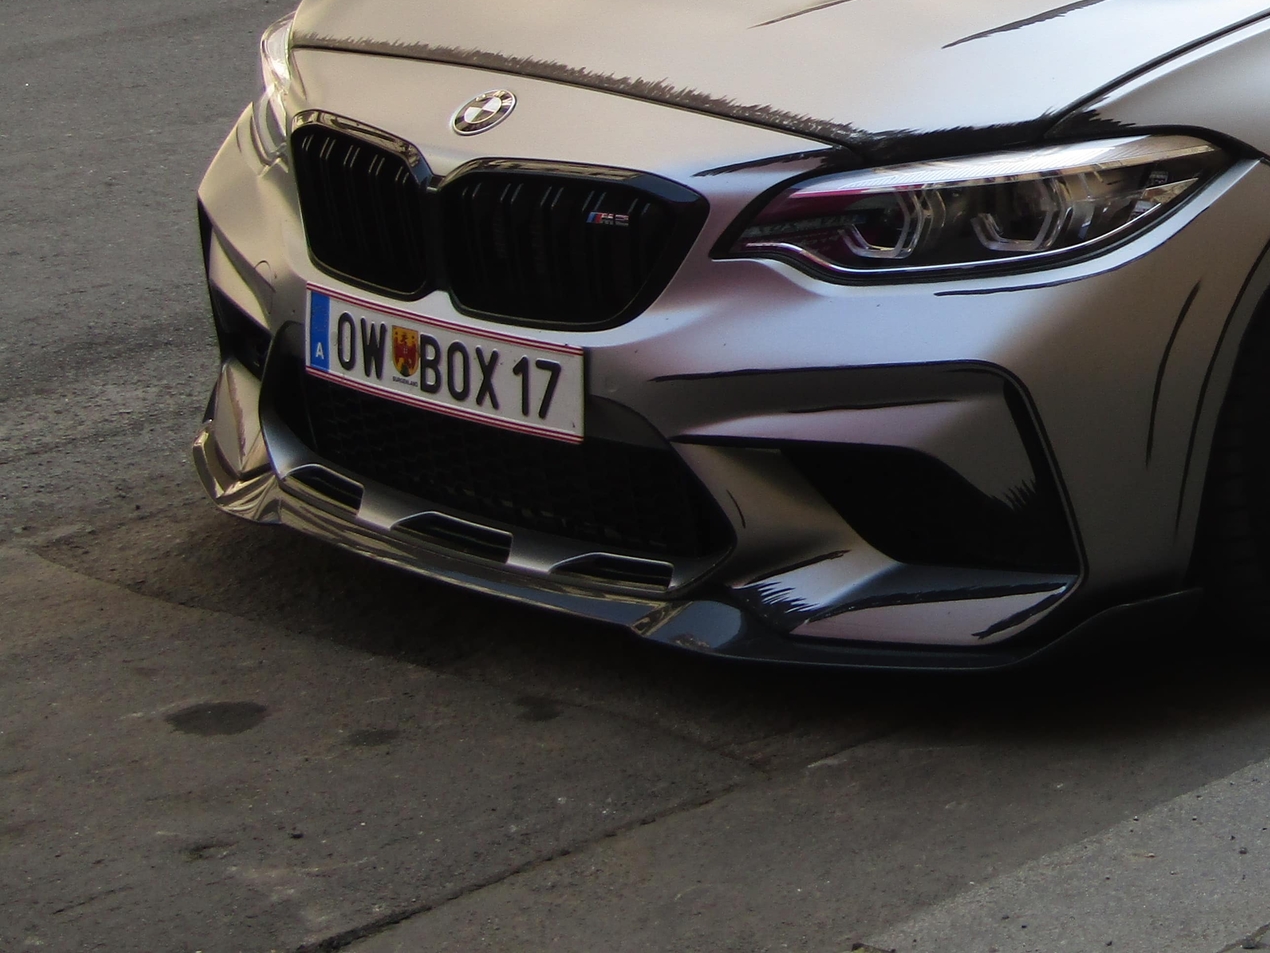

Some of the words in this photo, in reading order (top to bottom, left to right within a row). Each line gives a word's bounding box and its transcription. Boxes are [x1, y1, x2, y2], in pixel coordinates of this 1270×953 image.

[315, 342, 325, 360] A
[337, 311, 387, 381] OW
[419, 332, 499, 410] BOX
[512, 354, 562, 419] 17
